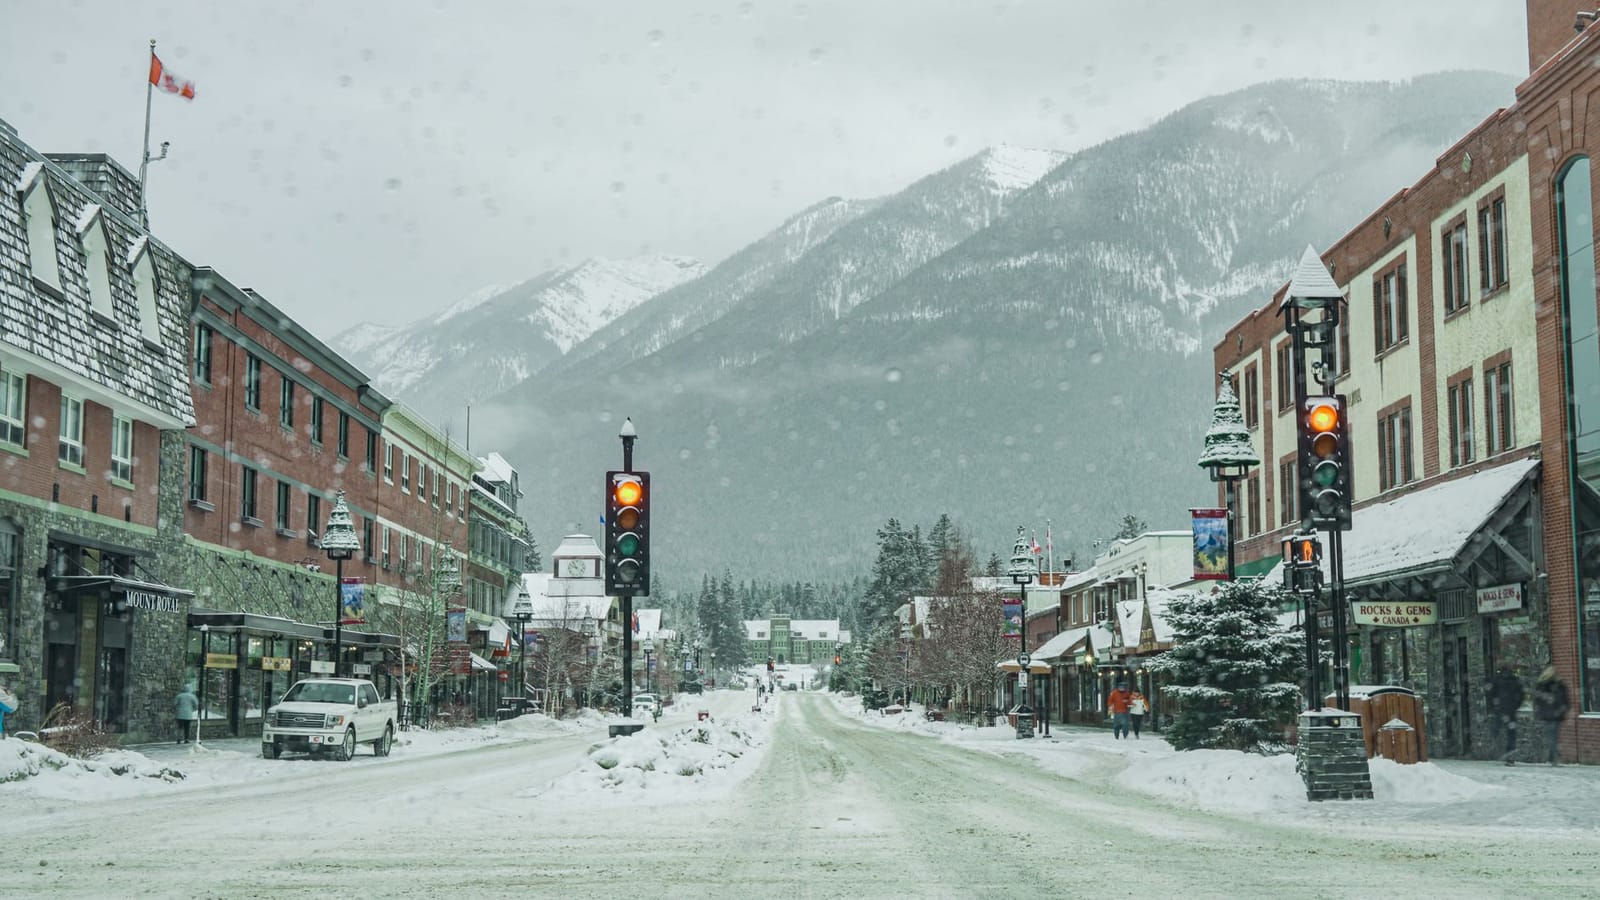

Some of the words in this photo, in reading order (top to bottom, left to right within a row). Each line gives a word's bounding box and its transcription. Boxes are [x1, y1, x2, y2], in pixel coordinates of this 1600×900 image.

[125, 590, 156, 610] MOUNT
[156, 596, 180, 613] ROYAL
[1360, 605, 1392, 615] ROCKS
[1395, 605, 1402, 616] &
[1406, 605, 1432, 616] GEMS
[1382, 616, 1410, 625] CANADA
